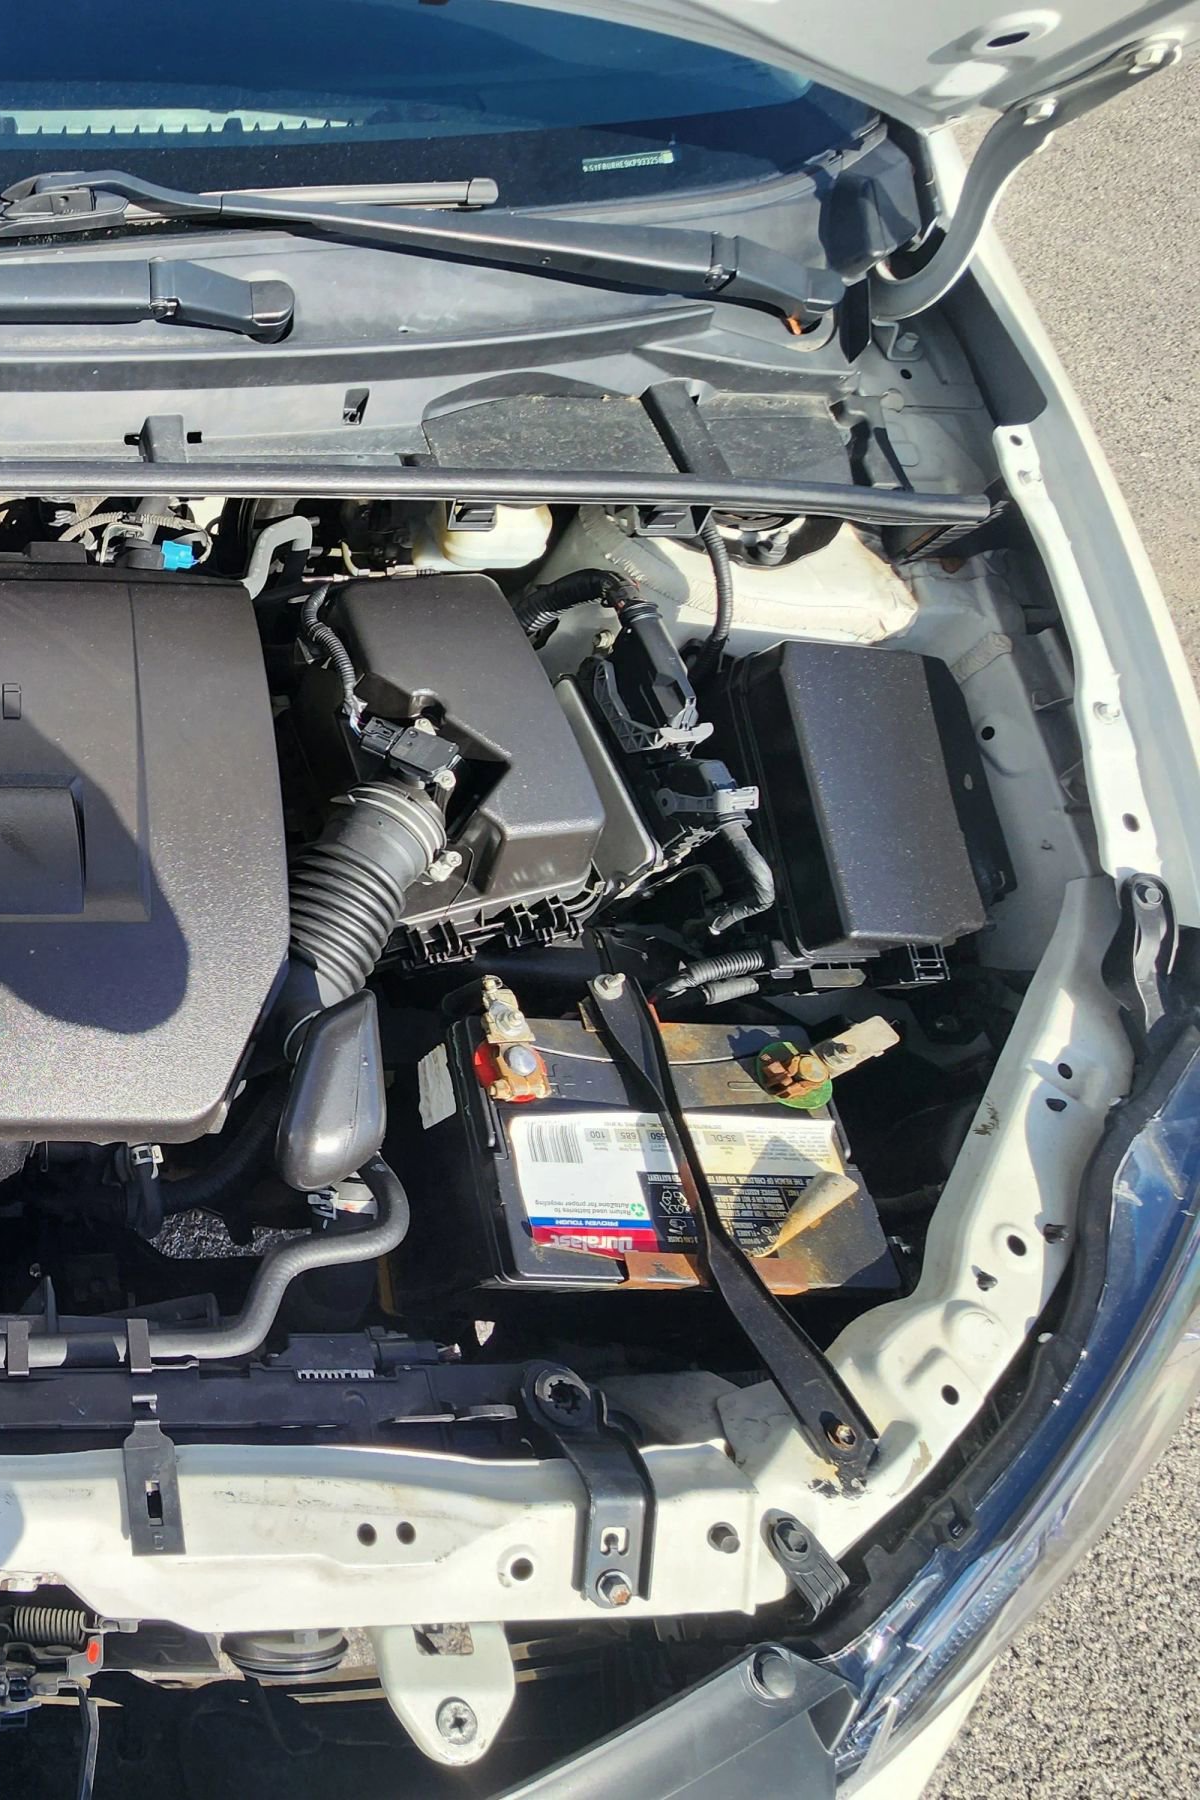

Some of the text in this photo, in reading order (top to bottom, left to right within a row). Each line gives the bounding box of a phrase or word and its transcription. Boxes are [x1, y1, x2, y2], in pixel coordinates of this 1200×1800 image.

[590, 1131, 606, 1139] 100
[535, 1199, 564, 1208] recycling
[565, 1200, 586, 1208] proper
[562, 1207, 591, 1215] batteries
[592, 1208, 608, 1216] used
[609, 1208, 631, 1216] Return
[554, 1219, 619, 1227] PROVEN TOUGH
[550, 1234, 636, 1254] Duralast
